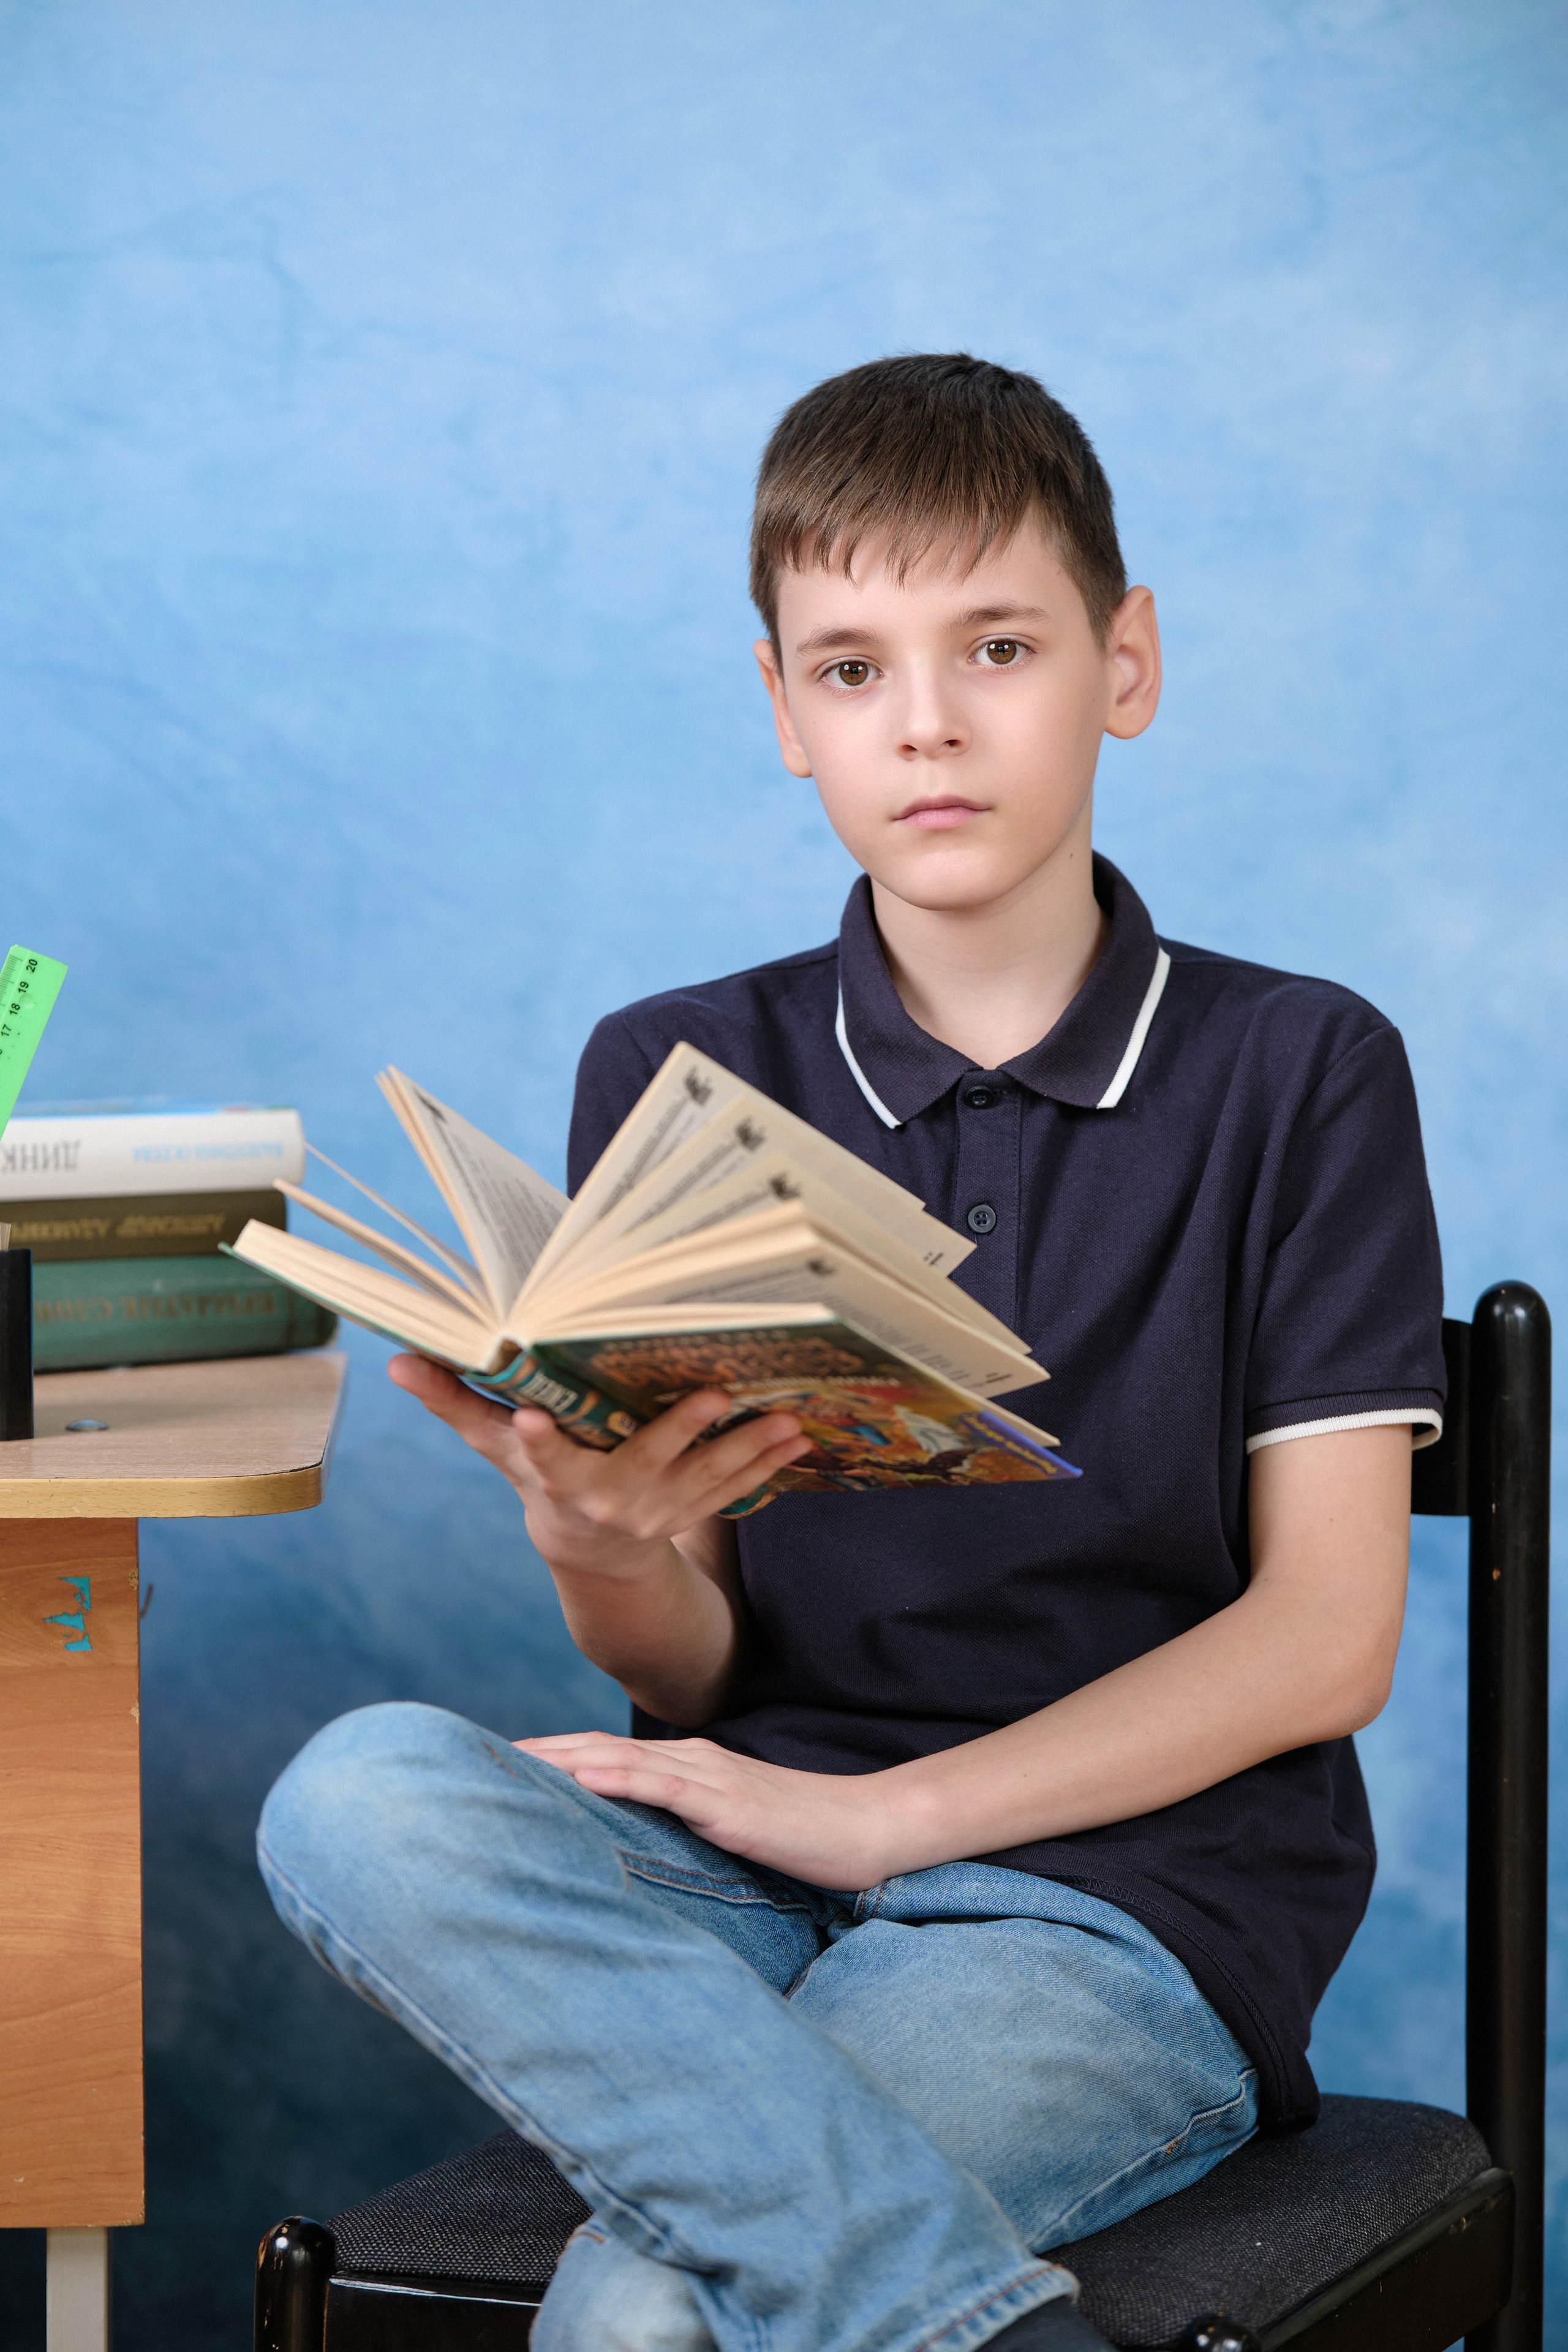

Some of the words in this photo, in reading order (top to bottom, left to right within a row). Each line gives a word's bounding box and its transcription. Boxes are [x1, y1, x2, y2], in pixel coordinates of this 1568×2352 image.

[26, 959, 38, 973] 20
[18, 981, 29, 993] 19
[9, 1003, 20, 1016] 18
[0, 1023, 12, 1037] 17
[34, 1296, 113, 1323] СЛОВ
